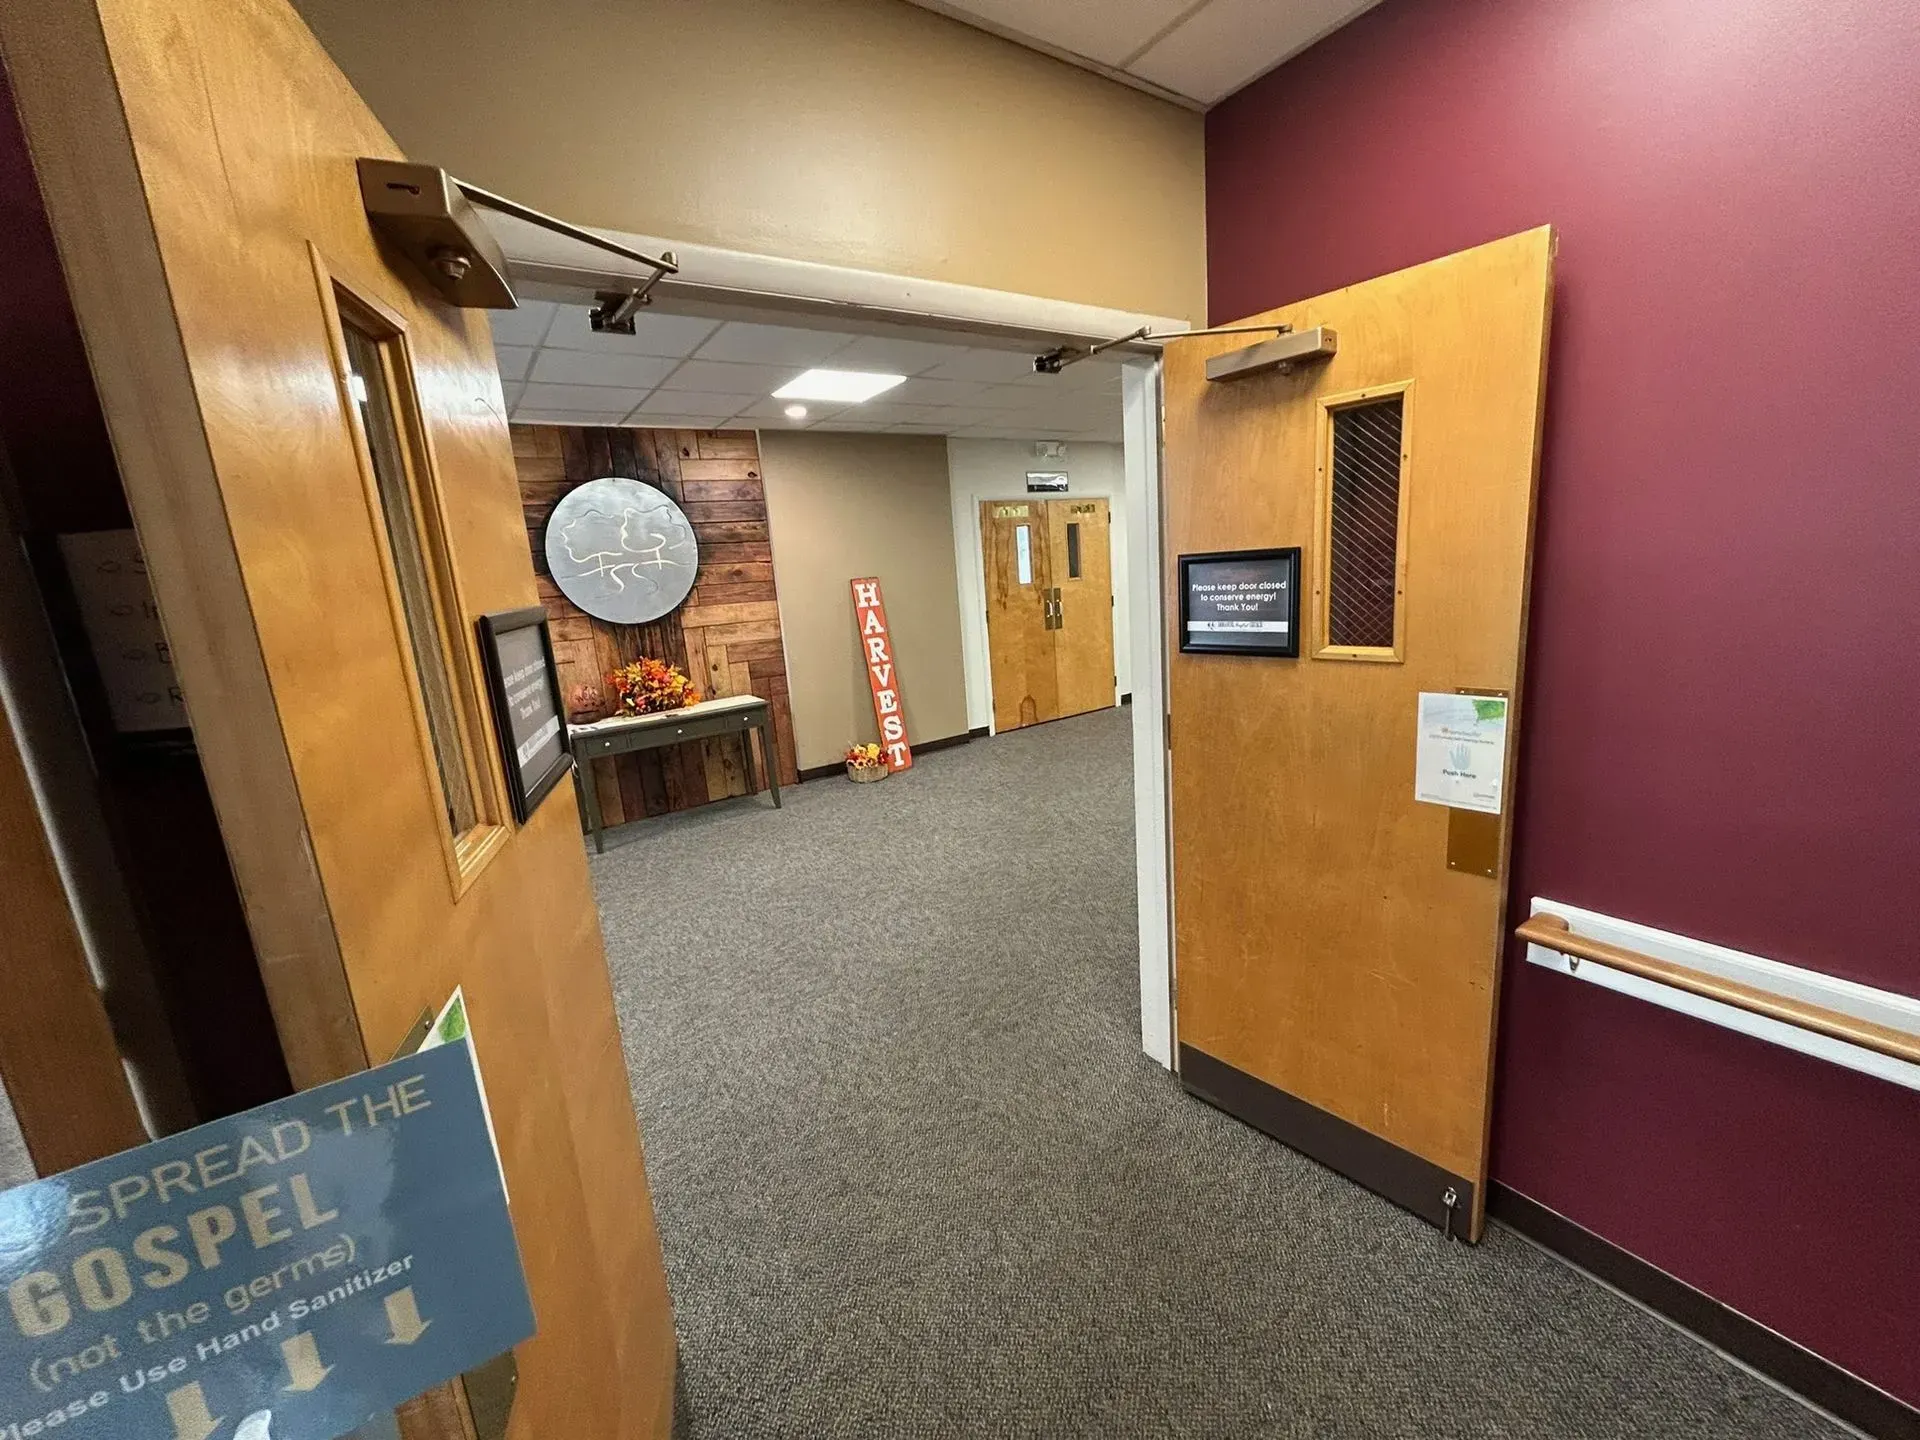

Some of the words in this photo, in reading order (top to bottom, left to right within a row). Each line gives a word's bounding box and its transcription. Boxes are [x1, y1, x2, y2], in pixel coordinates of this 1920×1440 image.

[1192, 584, 1216, 592] Please
[1217, 583, 1237, 592] keep
[1238, 582, 1257, 590] door
[1259, 580, 1287, 590] closed
[1216, 603, 1240, 611] Thank
[1240, 603, 1258, 611] You!
[1245, 592, 1277, 602] energy!
[854, 583, 907, 767] HARVEST
[68, 1119, 313, 1237] SPREAD
[323, 1074, 432, 1137] THE
[7, 1172, 340, 1338] GOSPEL
[30, 1333, 123, 1393] (not
[137, 1301, 210, 1344] the
[223, 1233, 357, 1316] germs)
[118, 1356, 188, 1393] Use
[197, 1312, 282, 1361] Hand
[289, 1254, 415, 1320] Sanitizer
